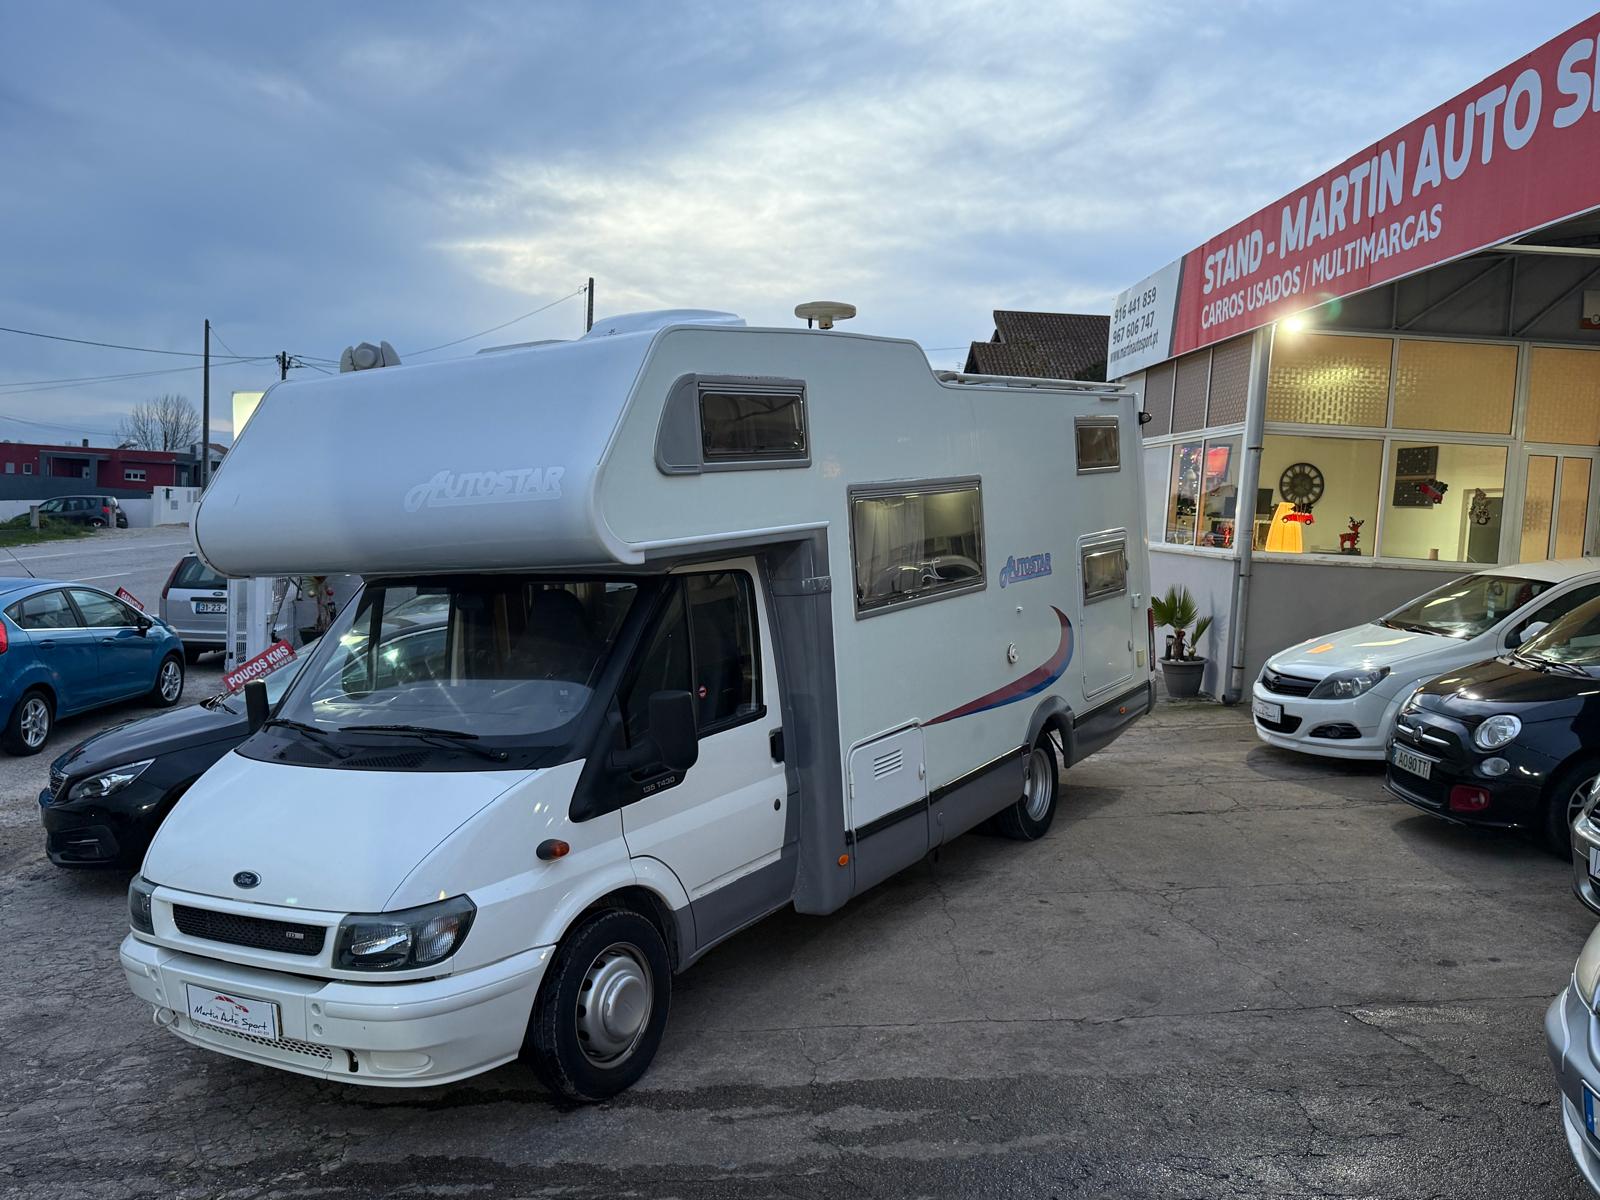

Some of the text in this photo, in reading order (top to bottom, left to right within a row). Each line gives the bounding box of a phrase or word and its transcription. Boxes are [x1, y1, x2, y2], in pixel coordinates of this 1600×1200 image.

[1203, 229, 1263, 295] STAND
[1280, 141, 1406, 259] MARTIN
[1412, 68, 1542, 197] AUTO
[1201, 291, 1244, 330] CARROS
[1247, 266, 1301, 311] USADOS
[1312, 203, 1443, 287] MULTIMARCAS
[1114, 286, 1157, 325] 916 441 859
[1112, 311, 1155, 345] 967 606 747
[227, 658, 268, 688] POUCOS
[266, 646, 289, 664] KMS
[194, 1005, 218, 1019] Martin
[221, 1012, 239, 1025] Auto
[242, 1018, 267, 1032] Sport
